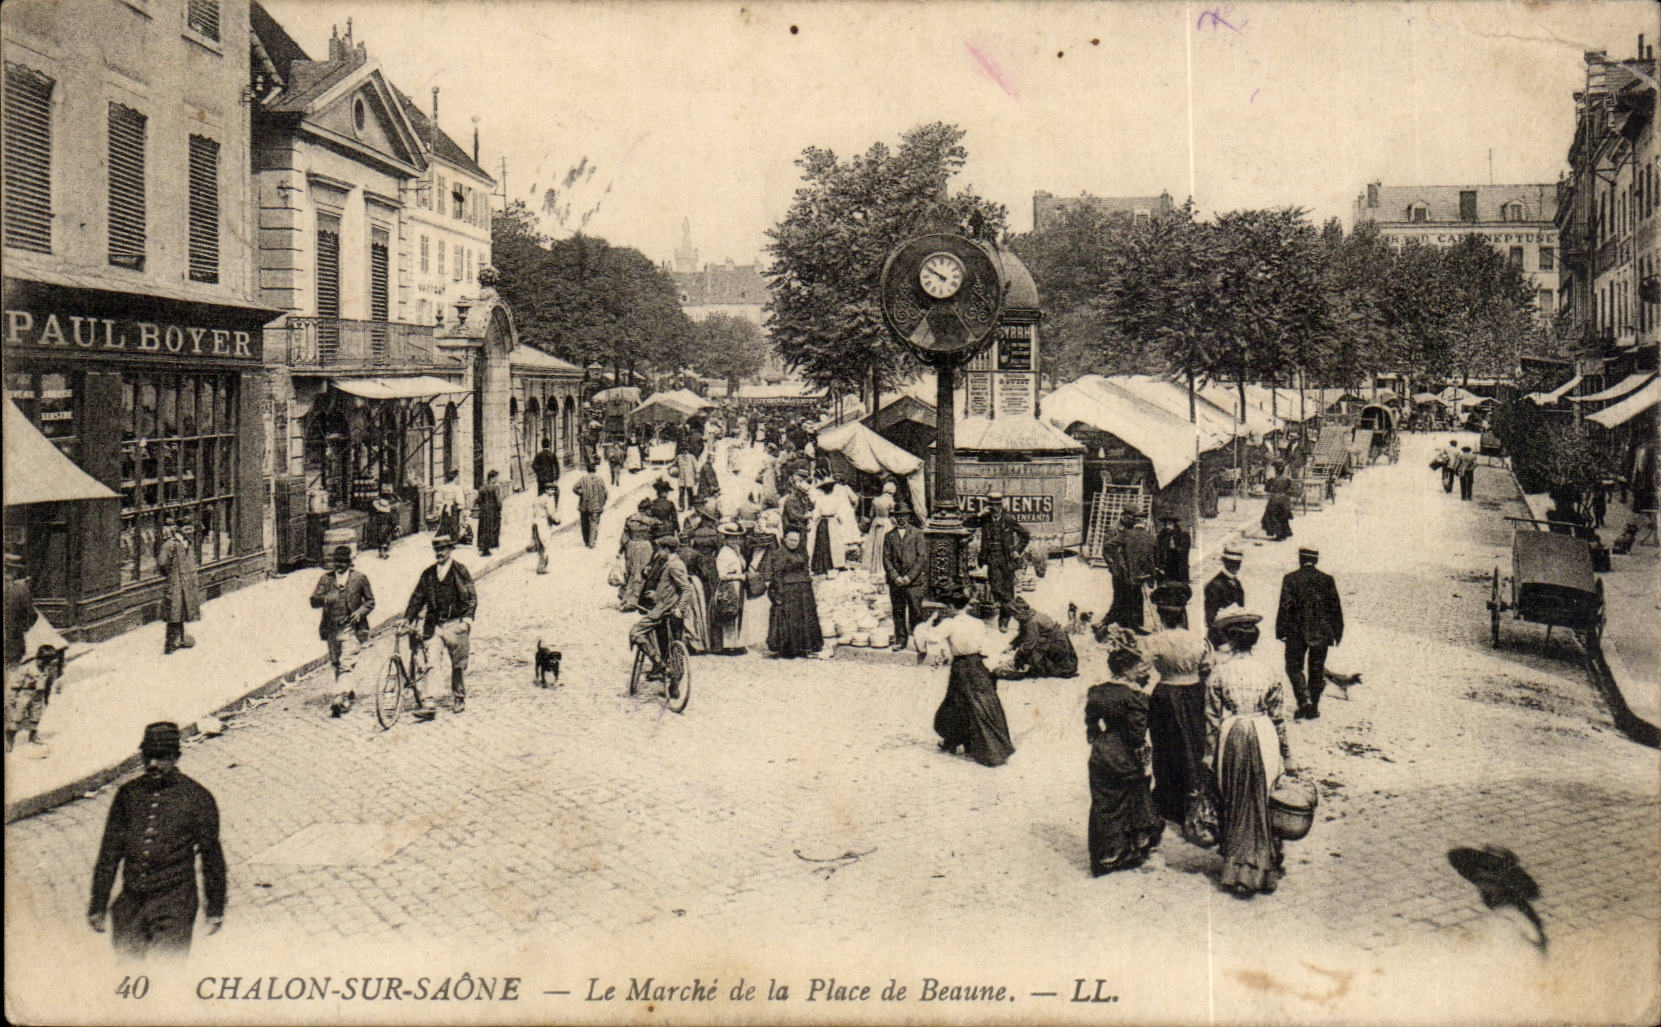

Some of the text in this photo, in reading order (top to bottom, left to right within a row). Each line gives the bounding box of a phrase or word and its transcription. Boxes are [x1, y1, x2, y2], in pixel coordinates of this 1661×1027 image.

[1382, 233, 1557, 244] RAND CAF NEPTUNE
[5, 309, 252, 357] PAUL BOYER
[957, 496, 1053, 513] VETMENTS
